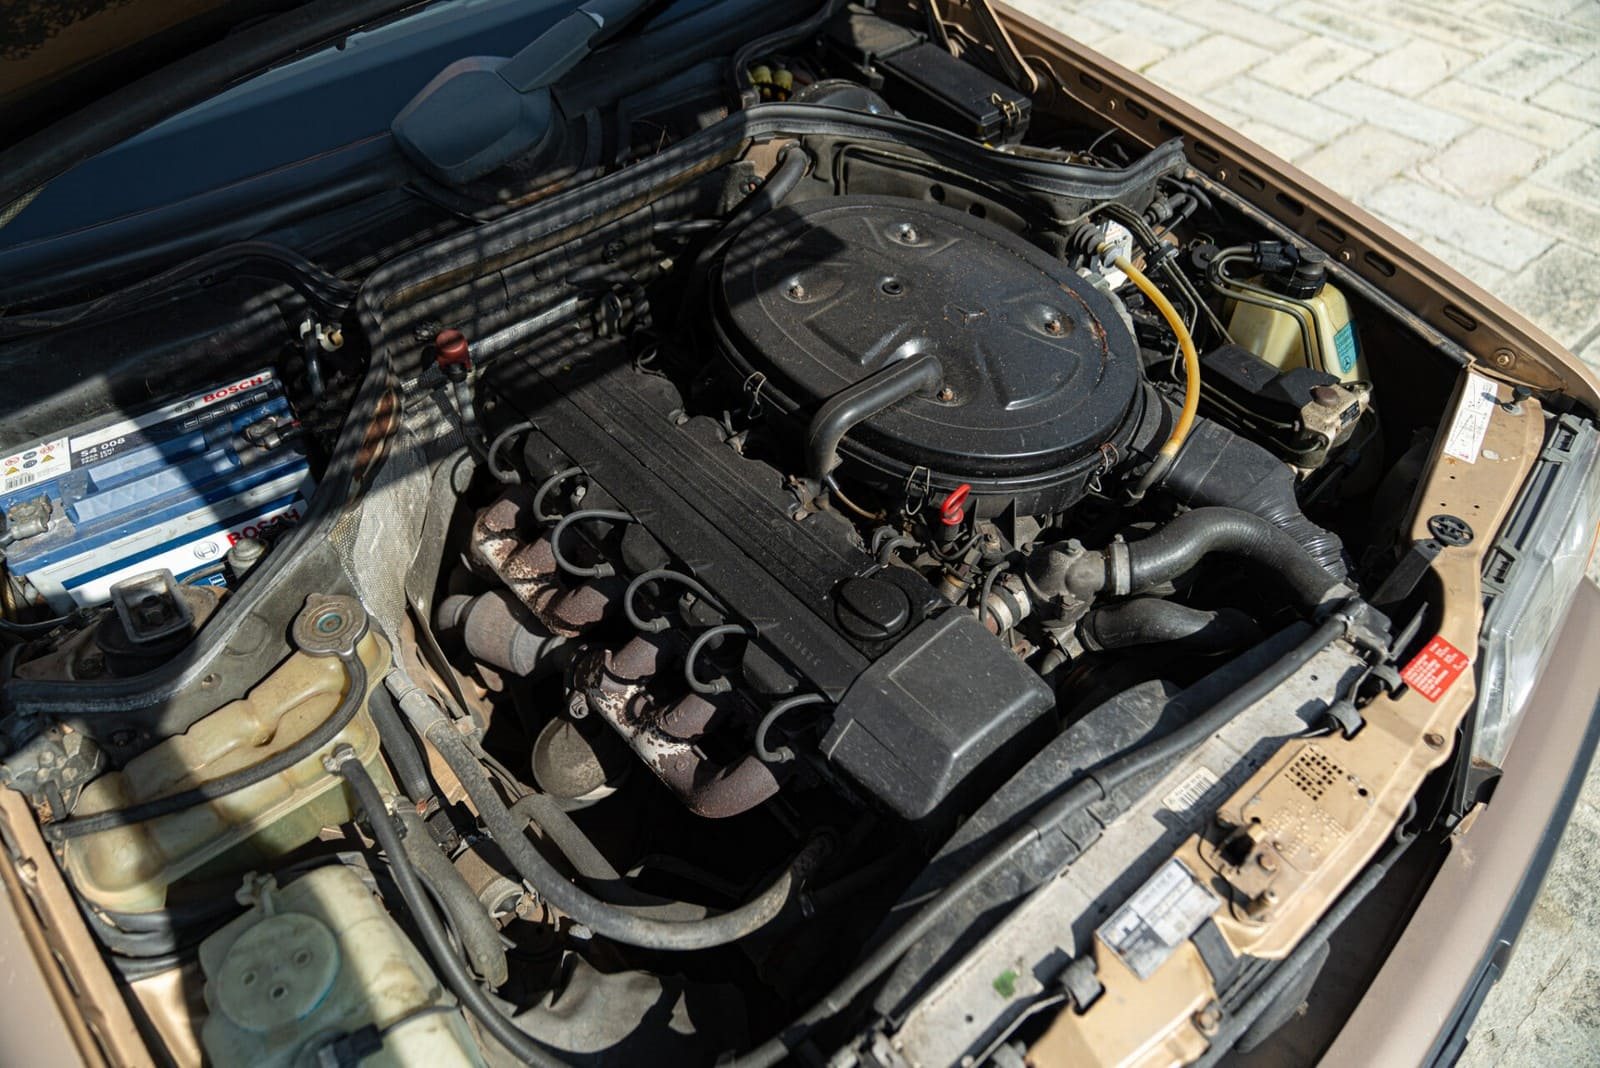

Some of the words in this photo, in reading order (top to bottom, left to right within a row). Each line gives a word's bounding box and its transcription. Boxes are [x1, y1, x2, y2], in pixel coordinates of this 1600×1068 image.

[203, 376, 263, 402] BOSCH
[80, 447, 98, 457] S4
[101, 437, 126, 450] 008
